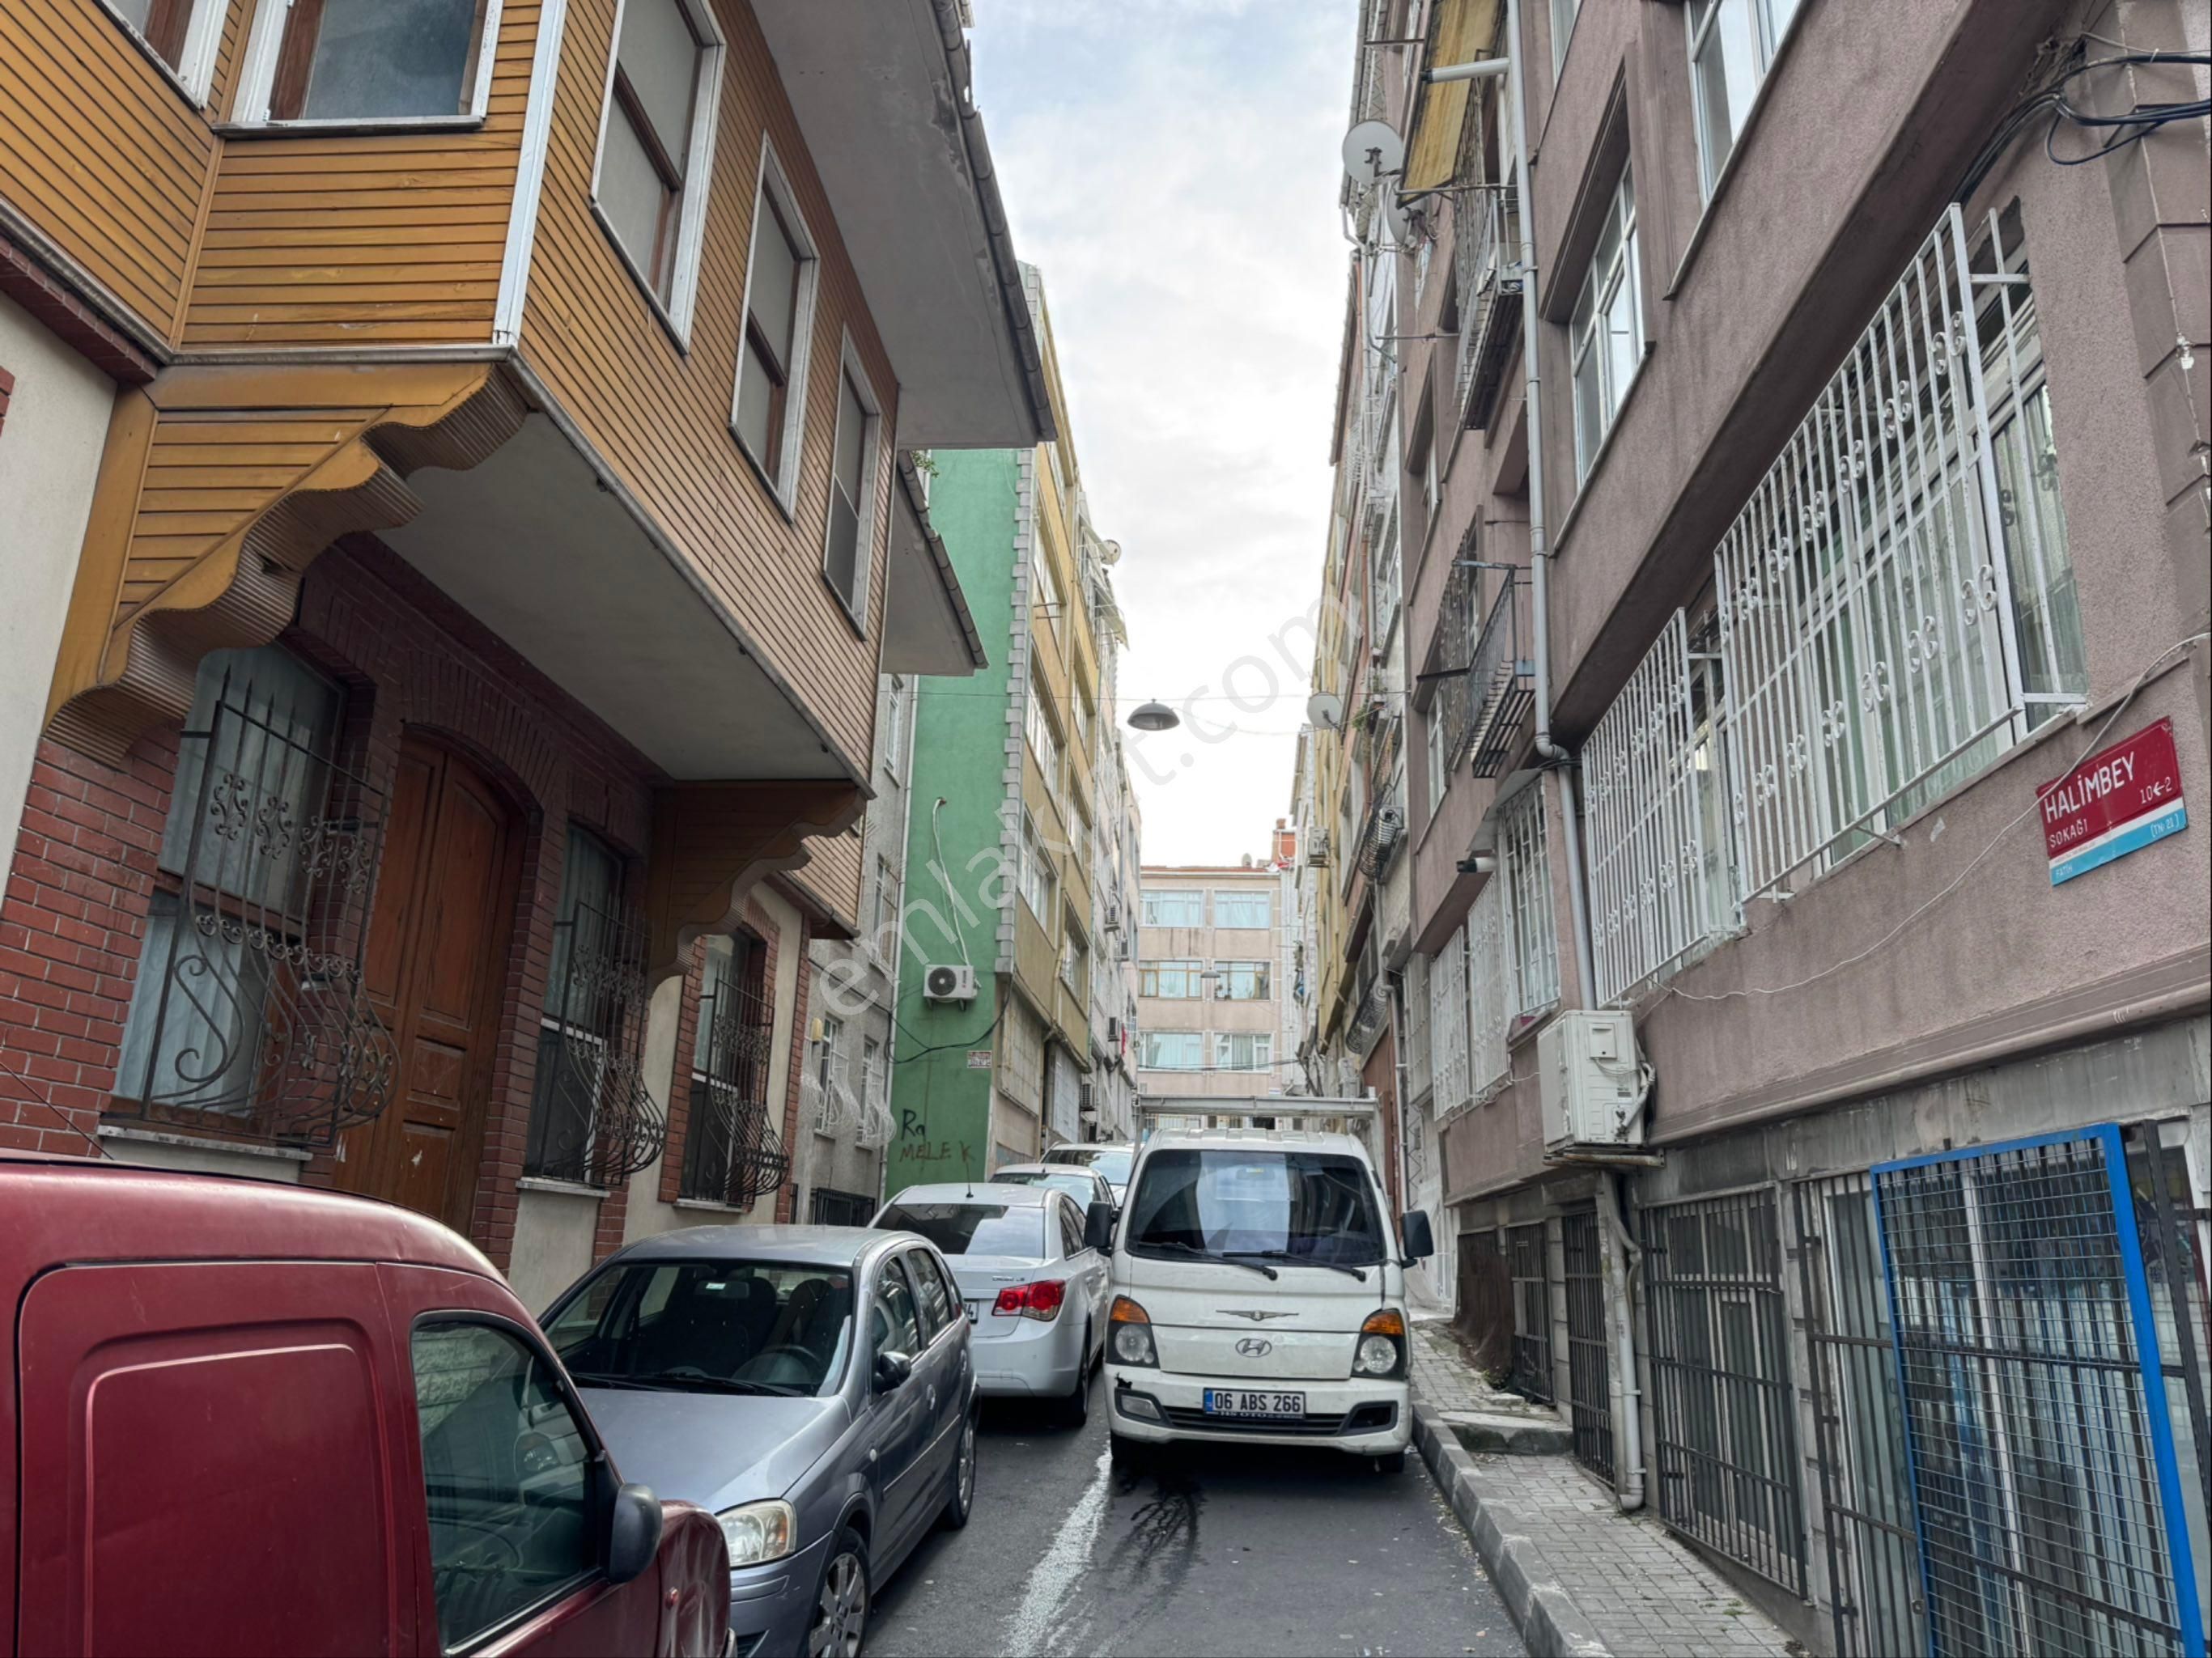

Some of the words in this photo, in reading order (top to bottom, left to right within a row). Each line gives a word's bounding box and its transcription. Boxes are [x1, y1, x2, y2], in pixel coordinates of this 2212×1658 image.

[2044, 751, 2134, 823] HALİMBEY
[2049, 819, 2088, 848] SOKAĞI
[1215, 1392, 1233, 1410] 06
[1240, 1393, 1267, 1411] ABS
[1273, 1395, 1301, 1413] 266
